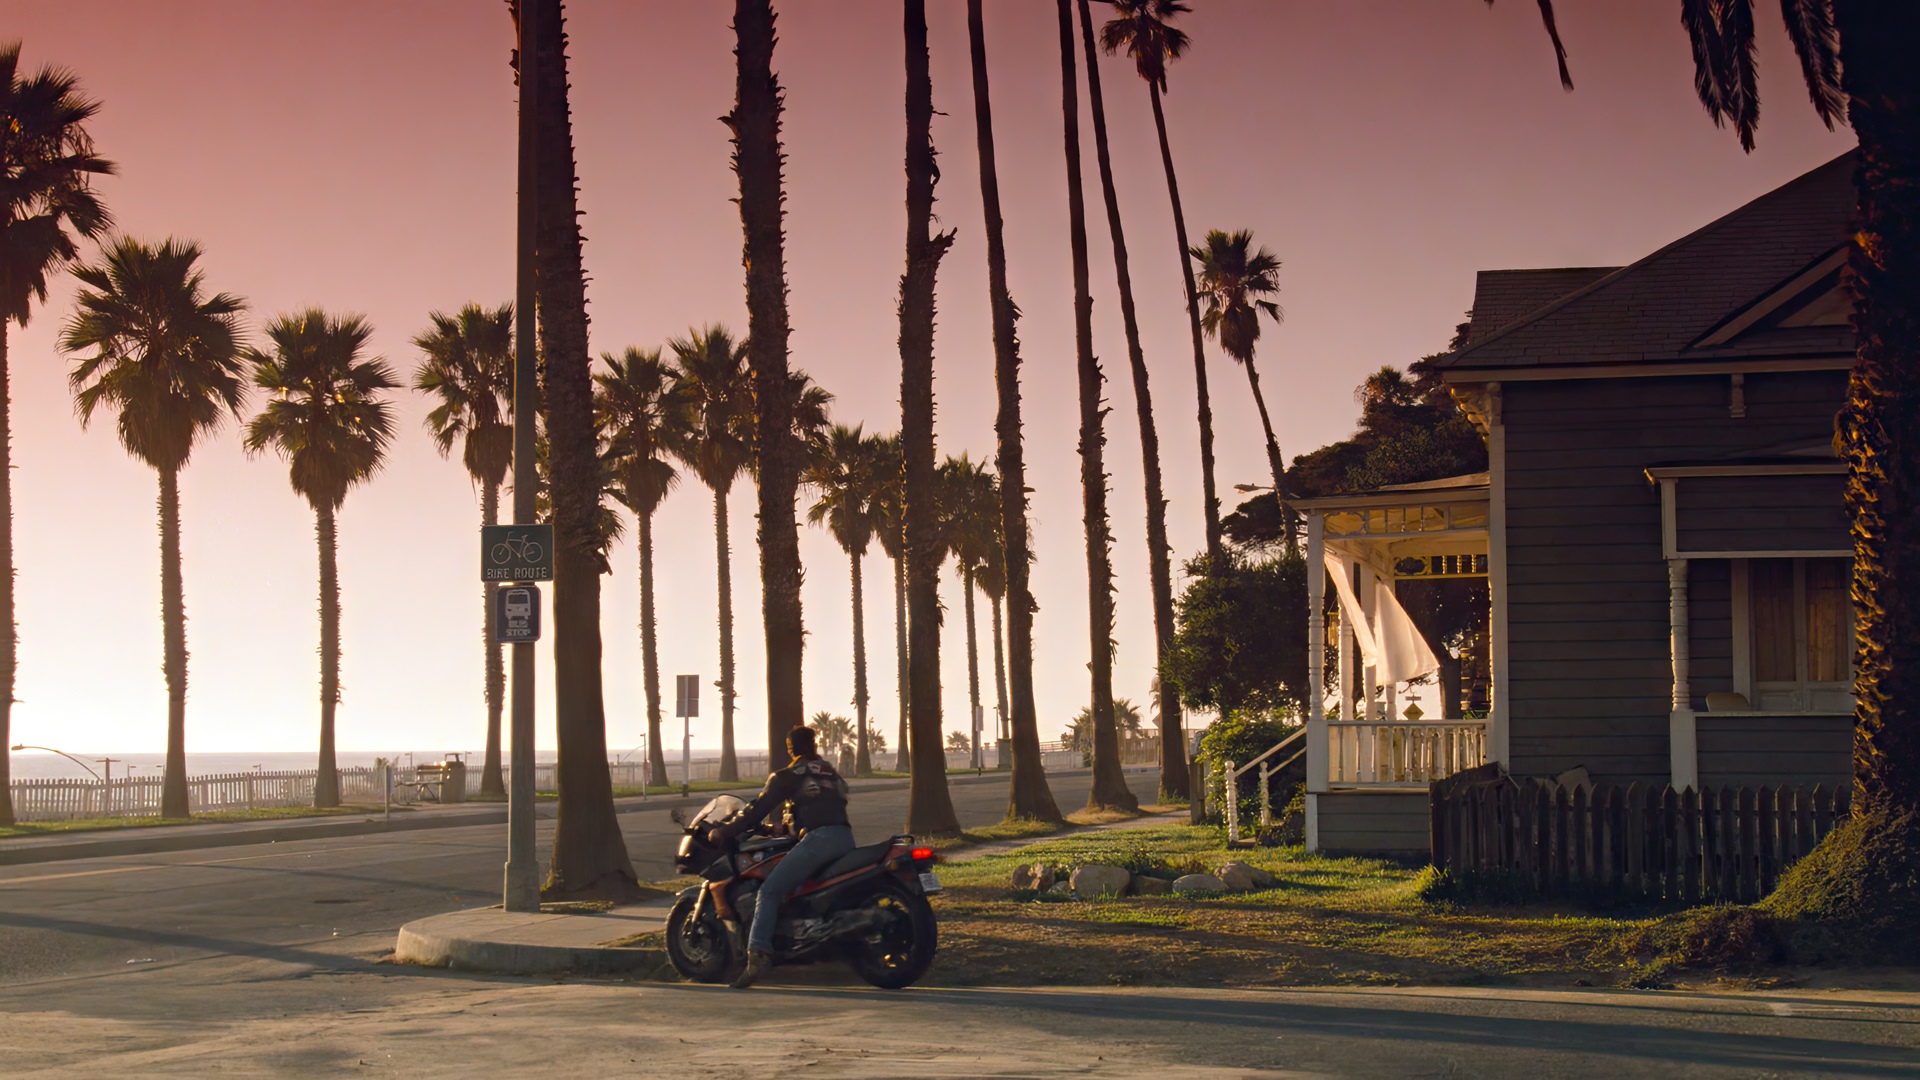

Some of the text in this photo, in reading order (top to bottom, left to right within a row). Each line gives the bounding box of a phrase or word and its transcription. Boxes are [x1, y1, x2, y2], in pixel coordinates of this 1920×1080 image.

[487, 566, 547, 579] BIKE ROUTE
[506, 628, 531, 637] STOP
